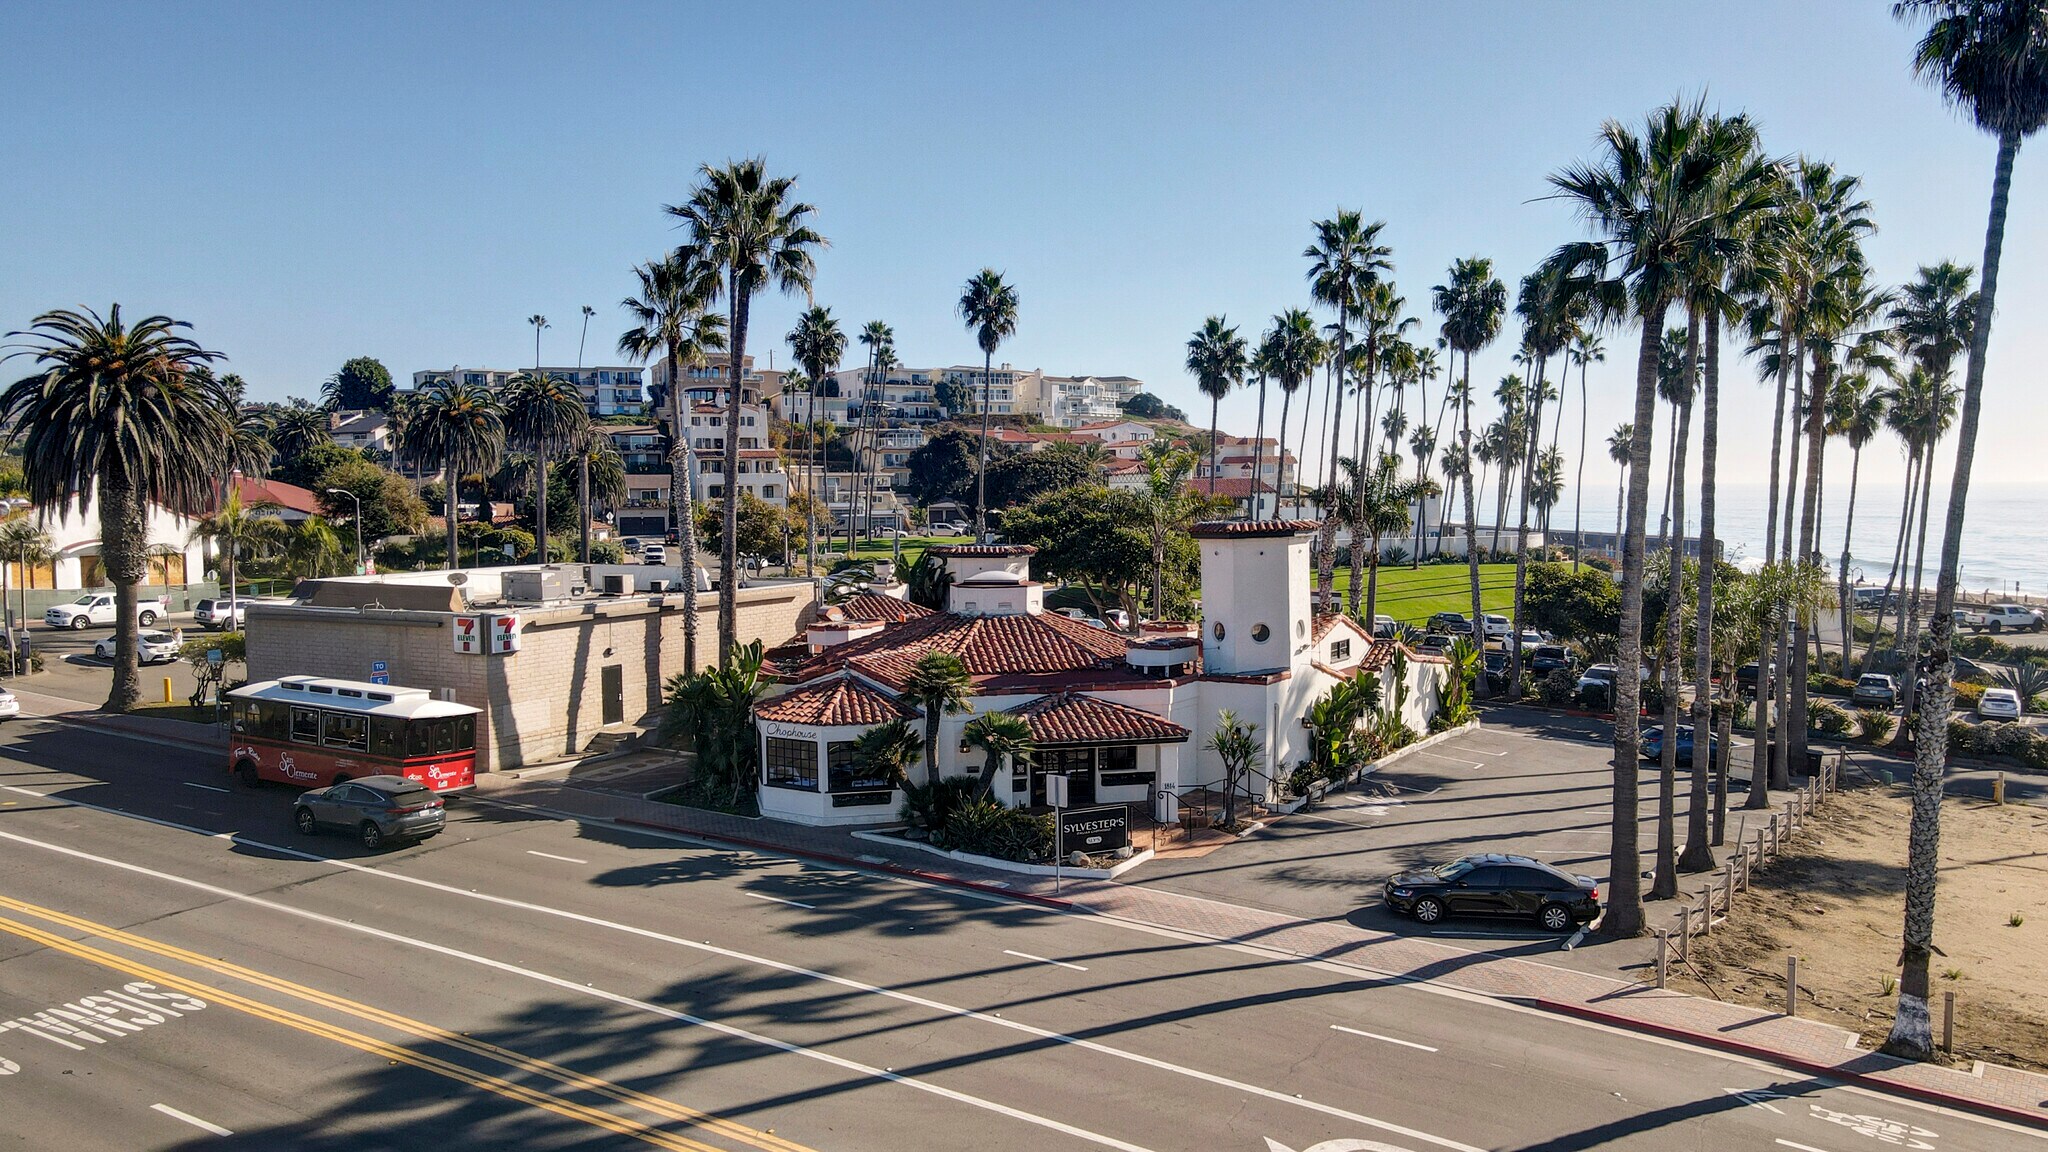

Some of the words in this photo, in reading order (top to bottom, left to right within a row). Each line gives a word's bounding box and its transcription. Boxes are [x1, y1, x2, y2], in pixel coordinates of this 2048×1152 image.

[457, 618, 475, 651] 7
[497, 617, 516, 651] 7
[377, 677, 384, 685] 5
[766, 722, 818, 739] Chophouse
[279, 751, 295, 772] San
[286, 763, 318, 780] Clemente
[1164, 782, 1176, 790] 1814
[1063, 817, 1125, 834] SYLVESTER'S
